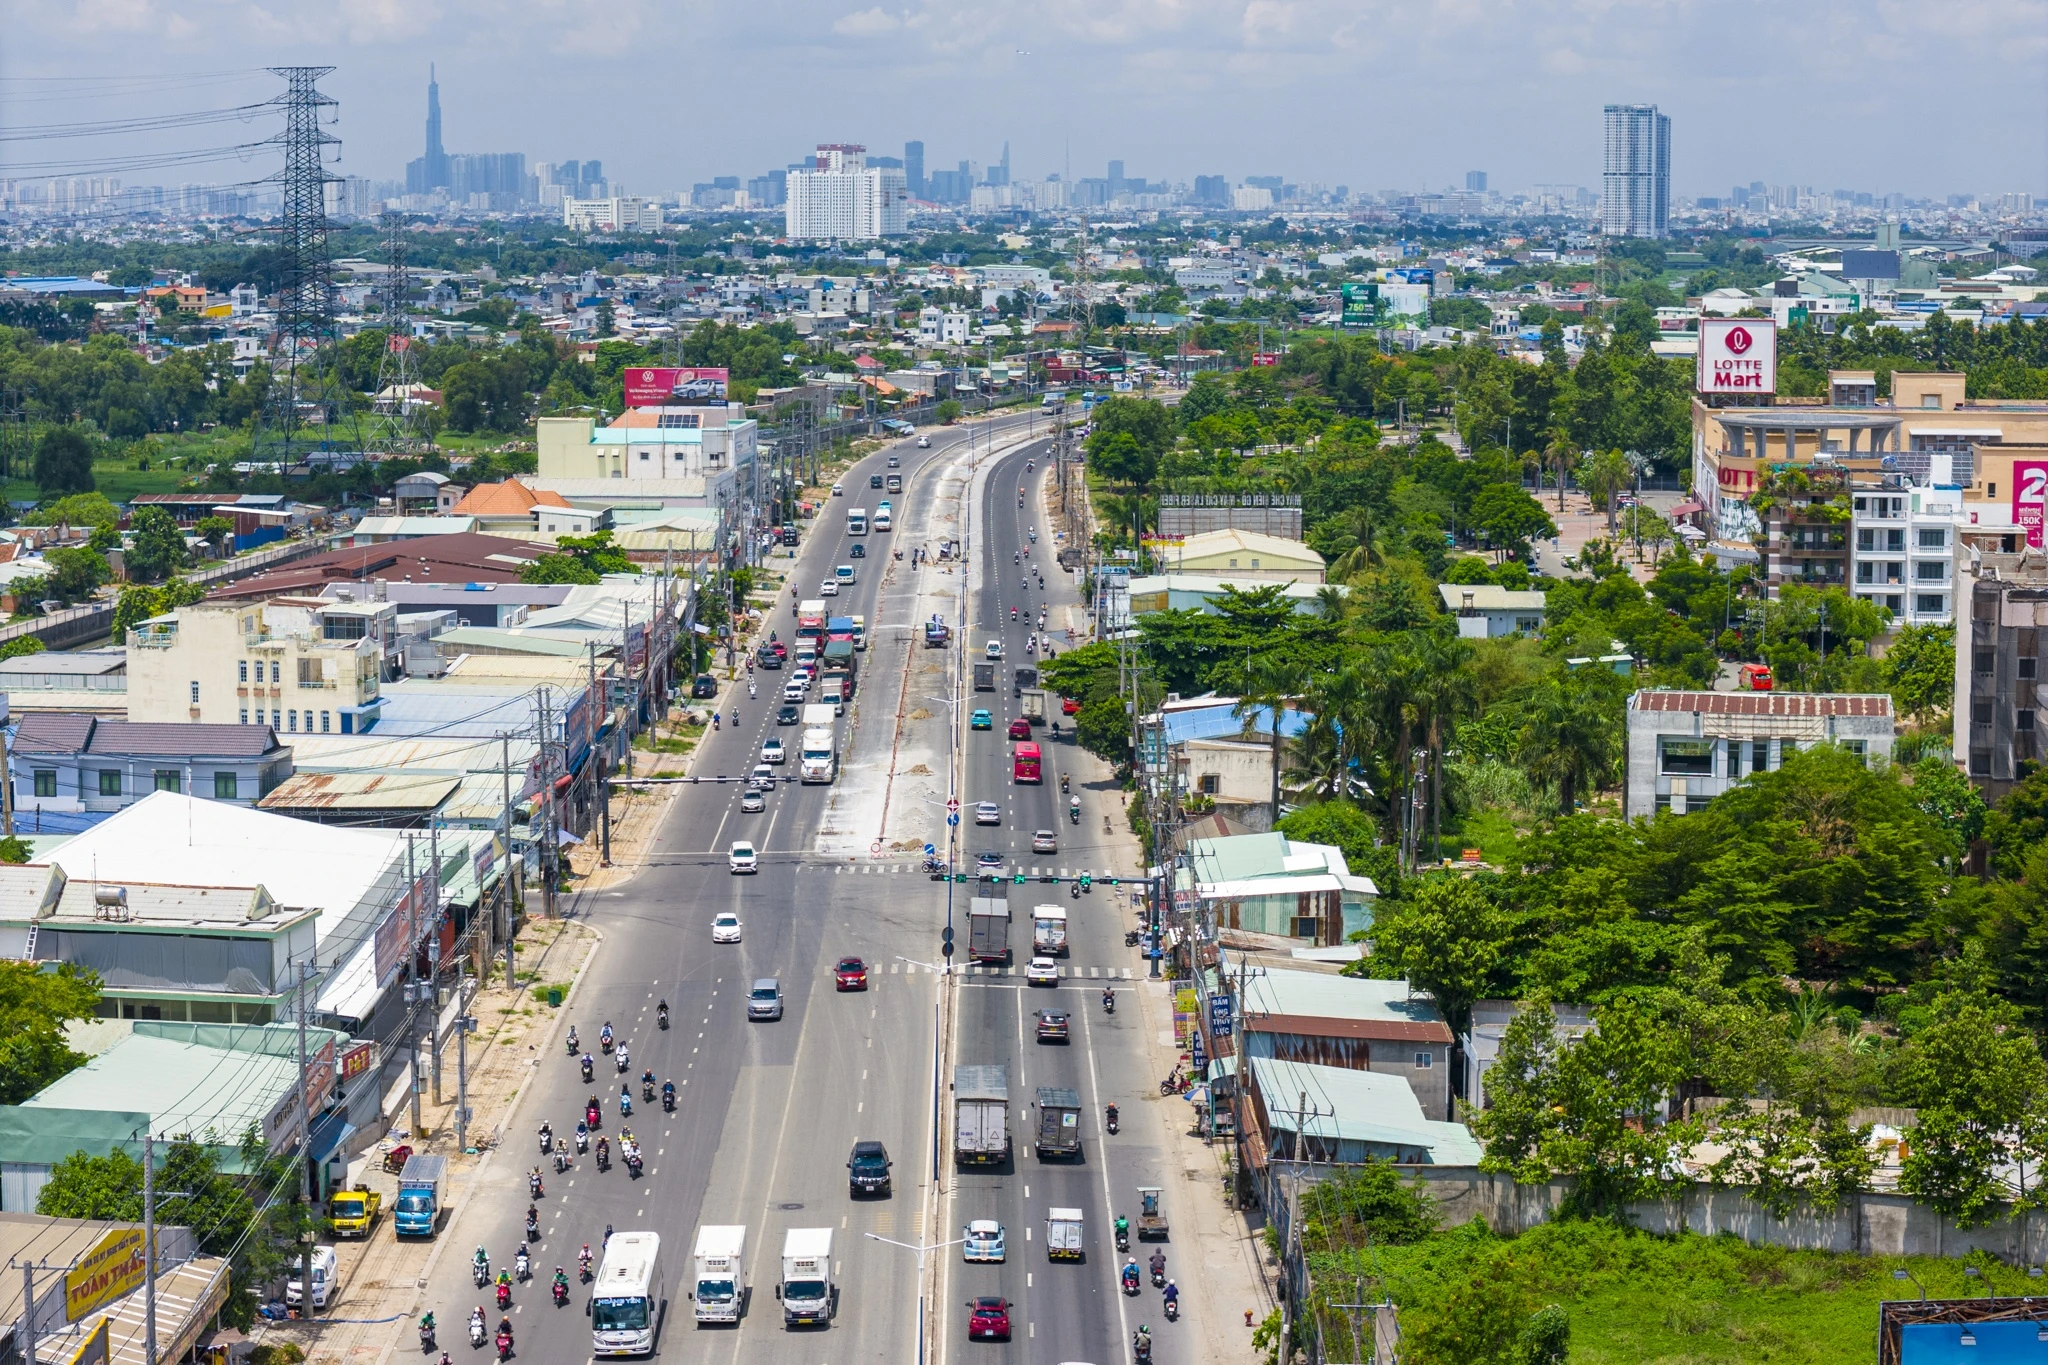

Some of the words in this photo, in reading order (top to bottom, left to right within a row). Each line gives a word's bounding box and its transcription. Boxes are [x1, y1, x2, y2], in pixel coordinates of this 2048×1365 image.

[1348, 303, 1364, 312] 750
[1714, 360, 1762, 370] LOTTE
[1714, 372, 1762, 387] Mart
[2018, 516, 2041, 525] 150K
[1015, 875, 1025, 883] 34
[1080, 876, 1091, 885] 34
[348, 1050, 367, 1075] P&T
[71, 1272, 109, 1304] TOÀN
